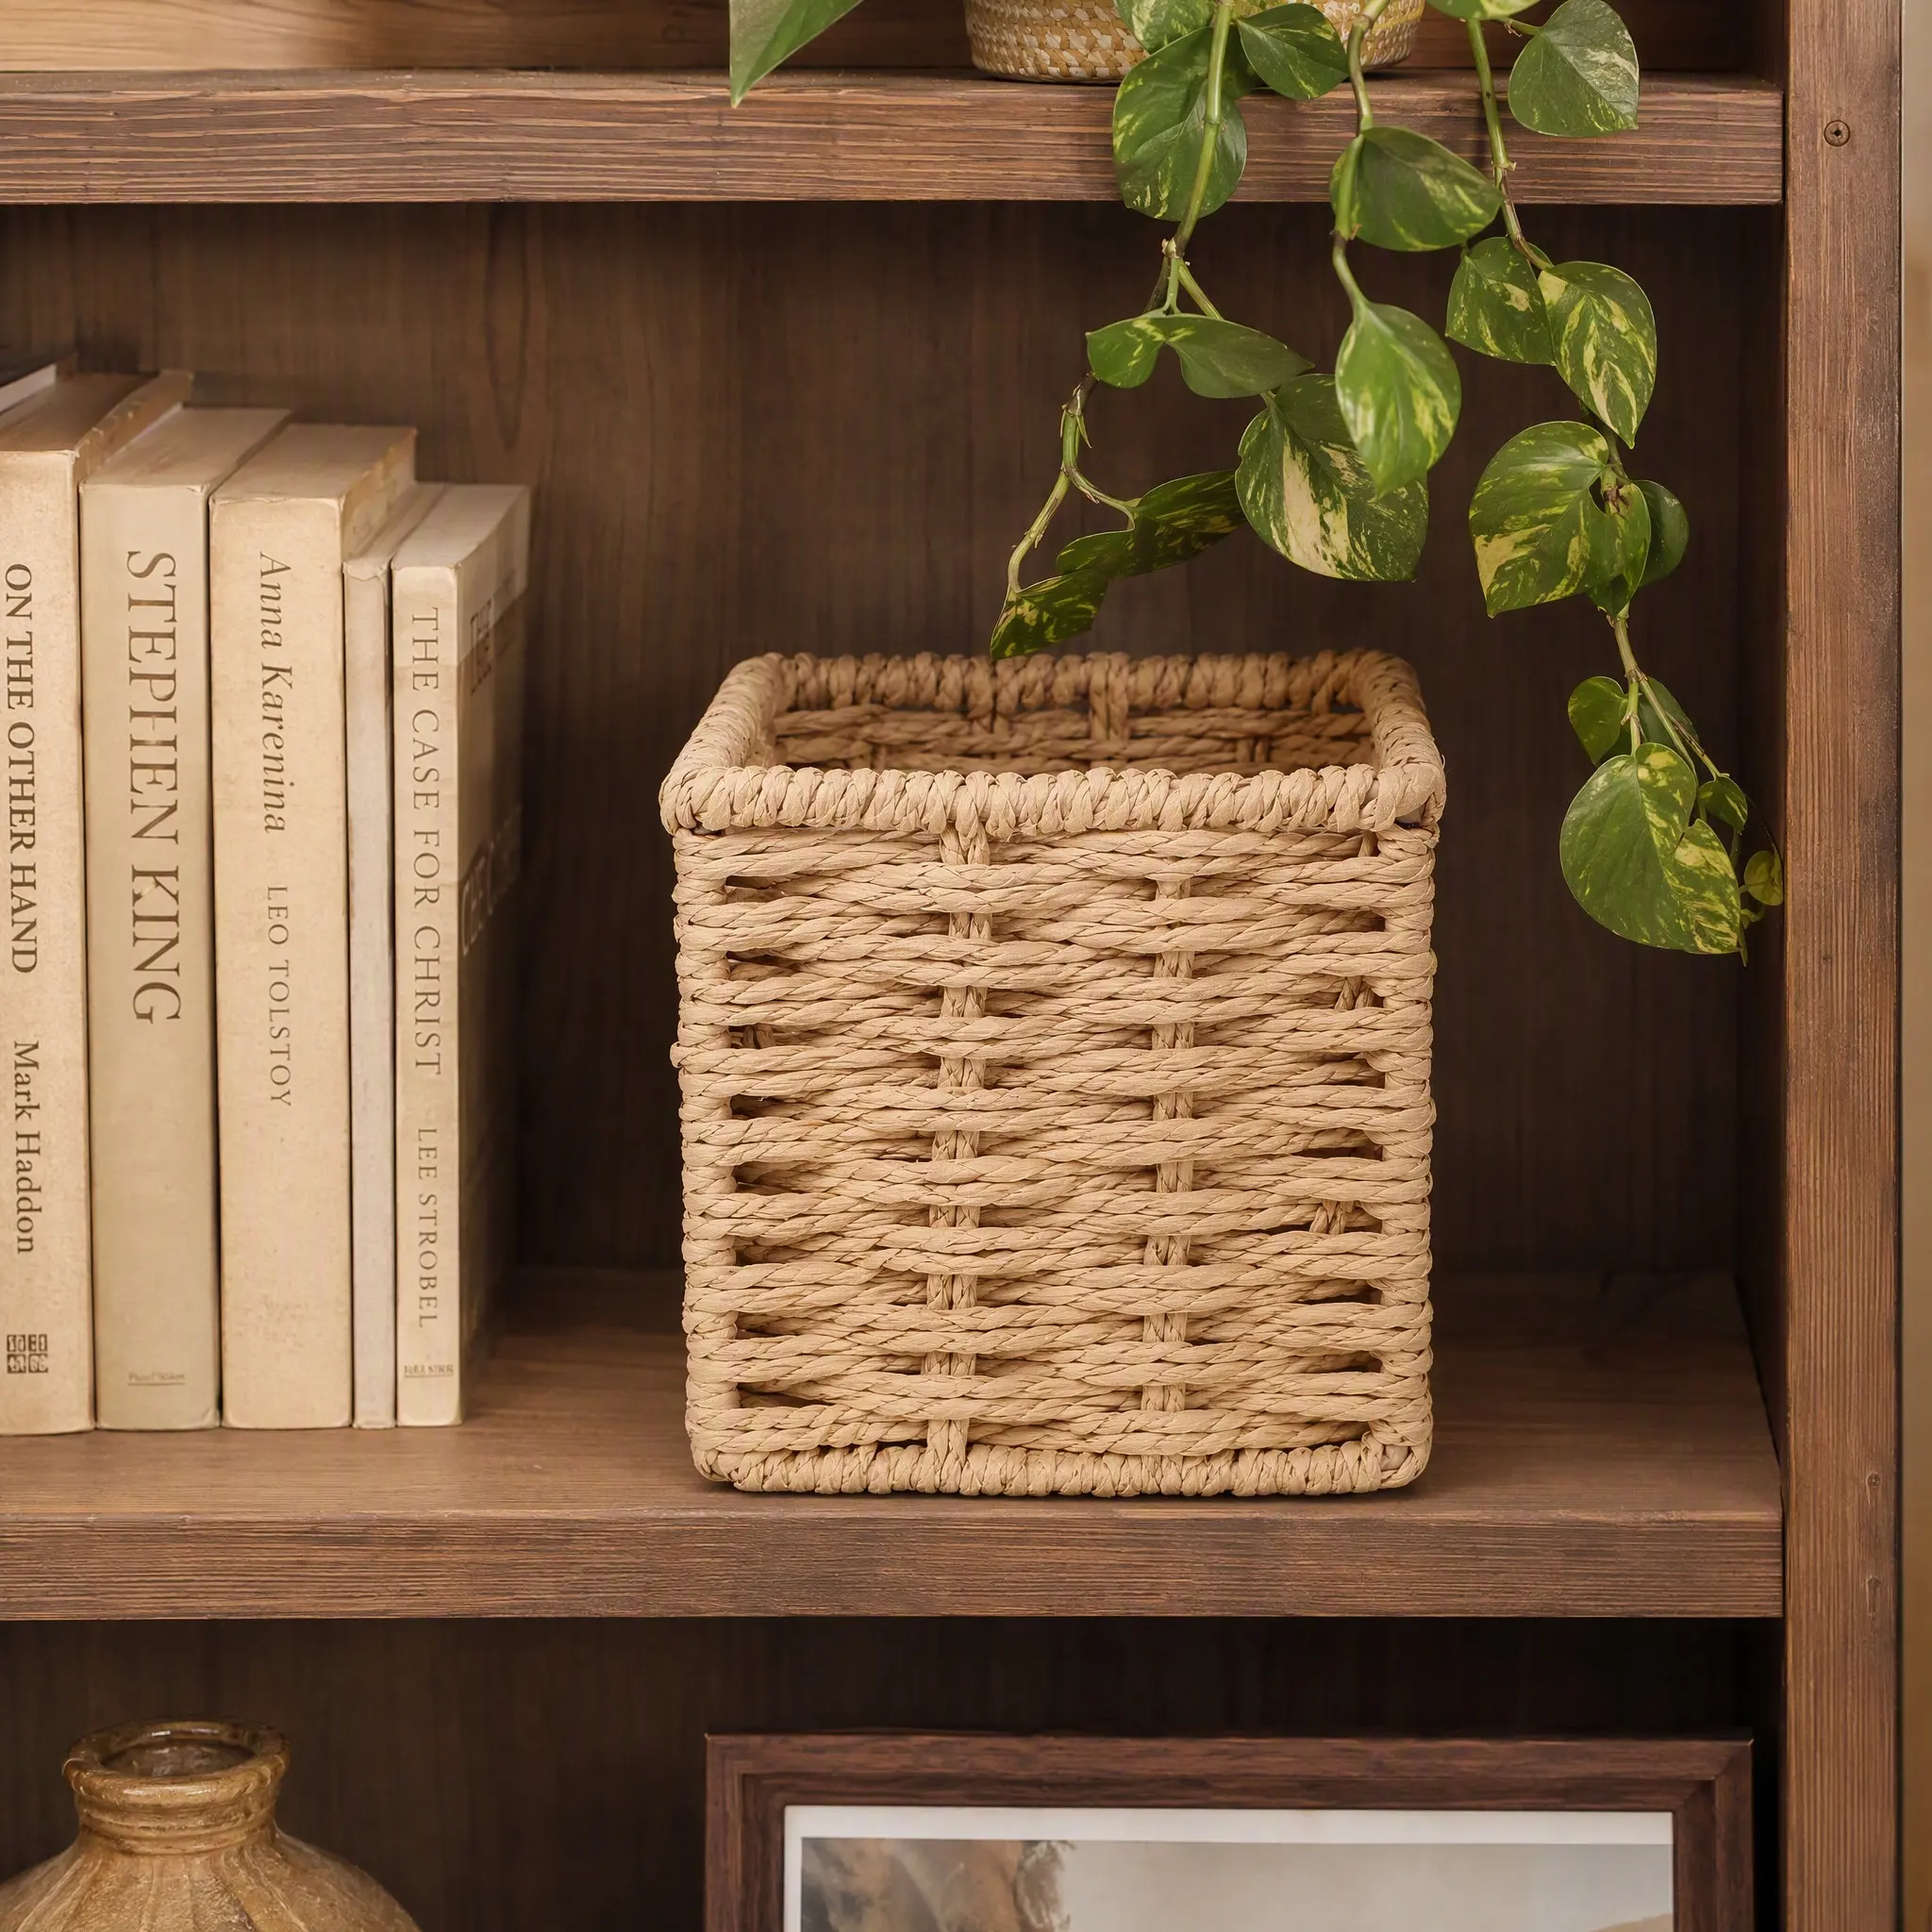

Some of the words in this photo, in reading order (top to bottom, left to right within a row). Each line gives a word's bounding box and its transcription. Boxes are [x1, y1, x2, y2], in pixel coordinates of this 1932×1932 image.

[4, 563, 33, 621] ON
[259, 551, 292, 650] Anna
[6, 630, 35, 710] THE
[125, 550, 179, 845] STEPHEN
[411, 606, 440, 691] THE
[7, 721, 37, 855] OTHER
[260, 662, 295, 834] Karenina
[411, 708, 441, 810] CASE
[9, 861, 39, 974] HAND
[267, 886, 290, 945] LEO
[413, 829, 441, 908] FOR
[131, 864, 182, 1024] KING
[268, 958, 292, 1108] TOLSTOY
[413, 925, 441, 1075] CHRIST
[13, 1040, 42, 1122] Mark
[15, 1130, 43, 1255] Haddon
[418, 1128, 439, 1180] LEE
[418, 1193, 439, 1328] STROBEL
